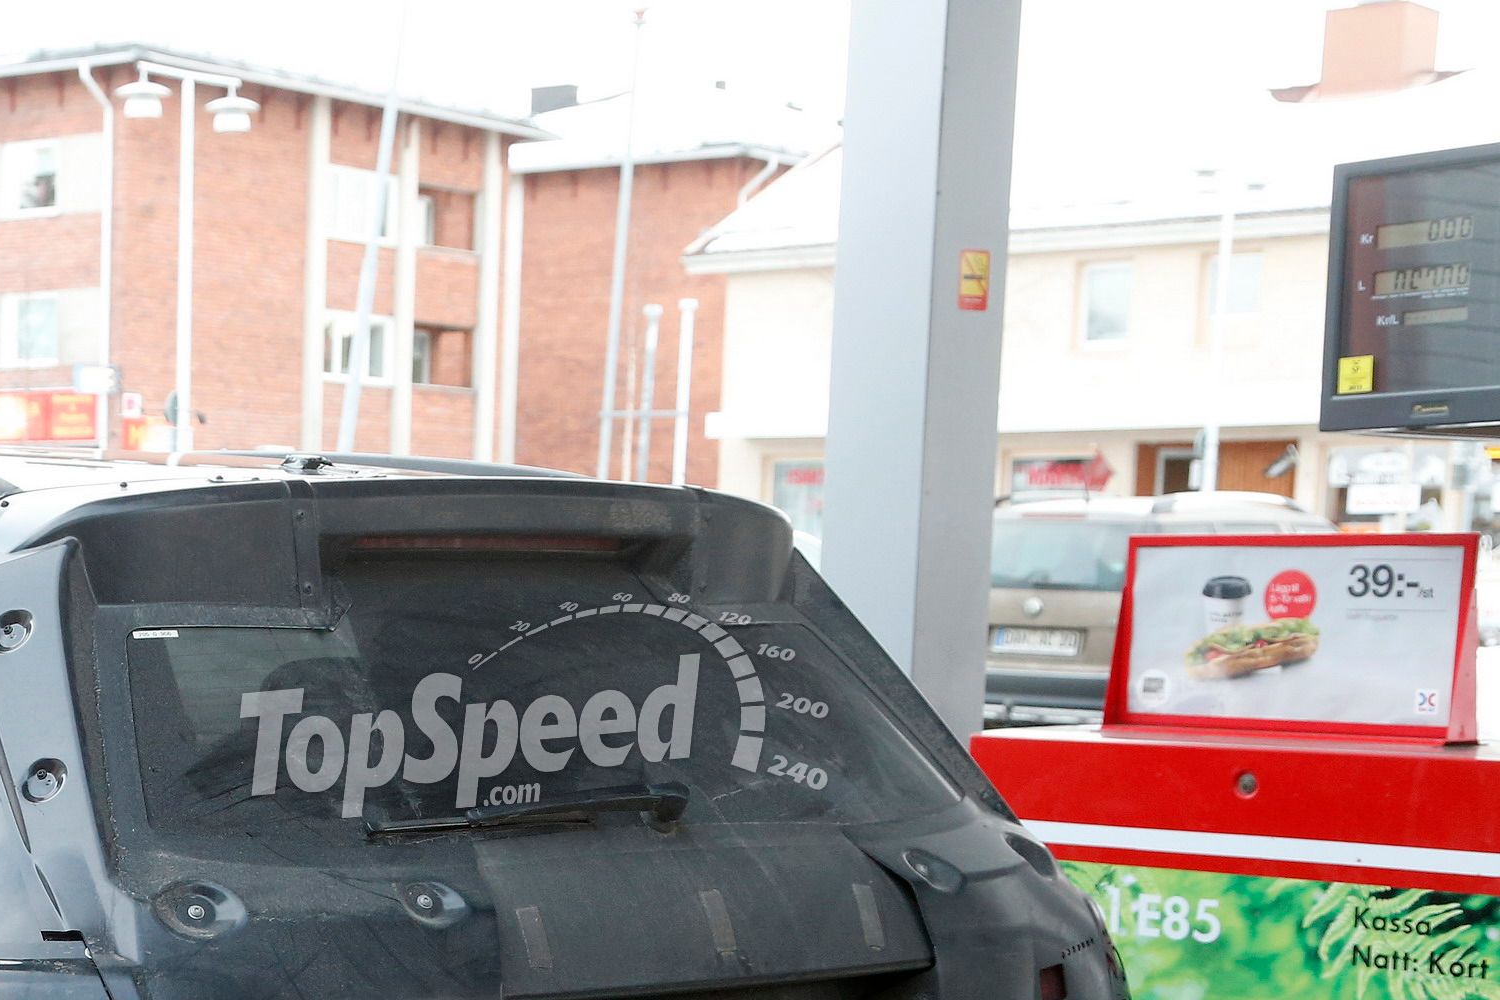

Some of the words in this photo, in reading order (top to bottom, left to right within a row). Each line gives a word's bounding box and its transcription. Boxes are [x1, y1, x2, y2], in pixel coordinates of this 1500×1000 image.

[1137, 892, 1221, 944] E85
[1353, 905, 1433, 938] Kassa
[1351, 944, 1419, 974] Natt:
[1428, 951, 1490, 980] Kort
